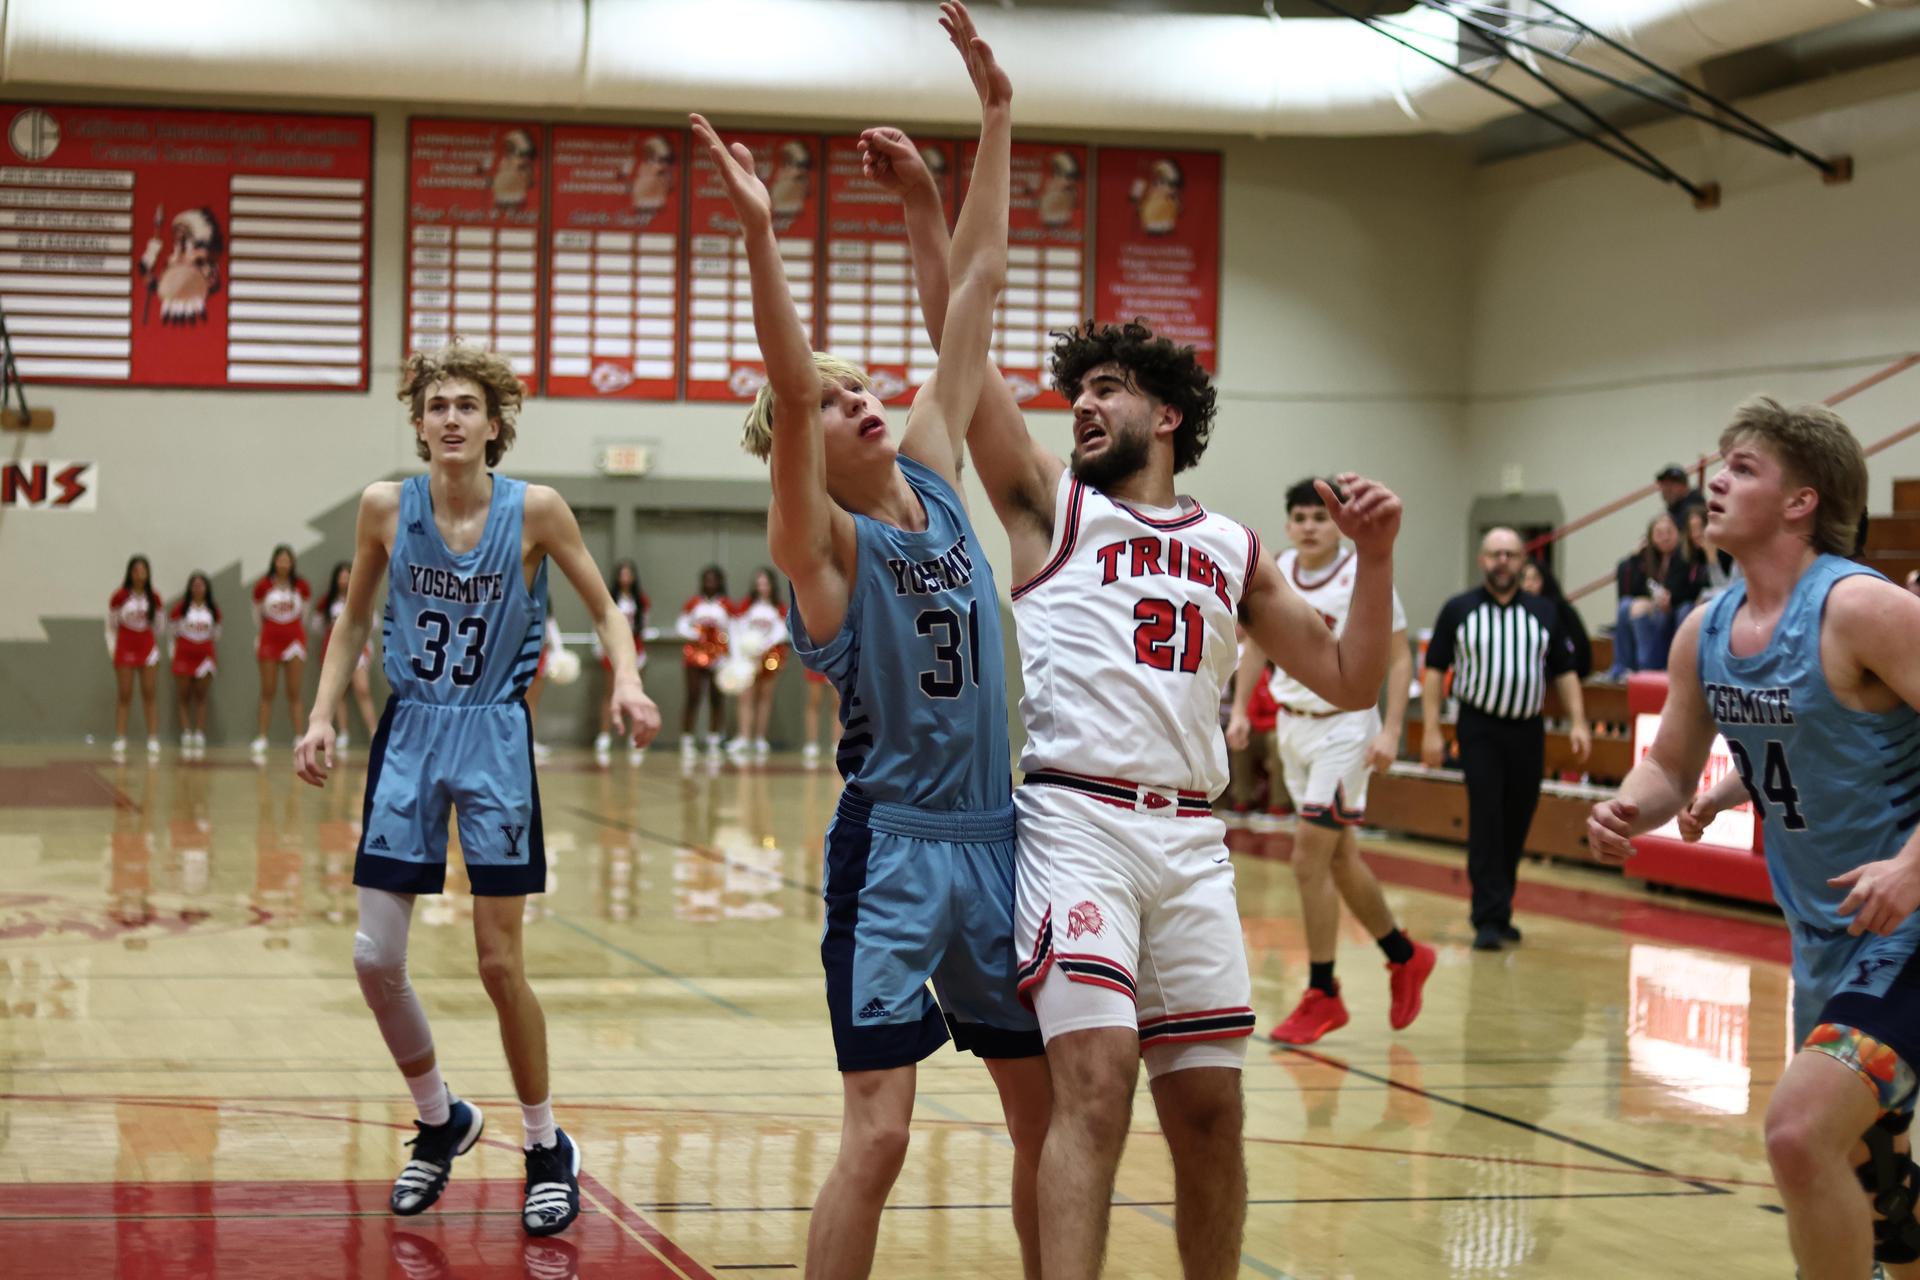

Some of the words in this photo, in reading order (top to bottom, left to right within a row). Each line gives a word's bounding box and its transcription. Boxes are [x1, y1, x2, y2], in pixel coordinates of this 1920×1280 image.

[409, 563, 504, 605] YOSEMITE
[410, 609, 489, 688] 33
[1133, 597, 1205, 674] 21
[1704, 681, 1796, 726] OSEMITE
[500, 824, 526, 858] Y
[1847, 957, 1898, 987] Y
